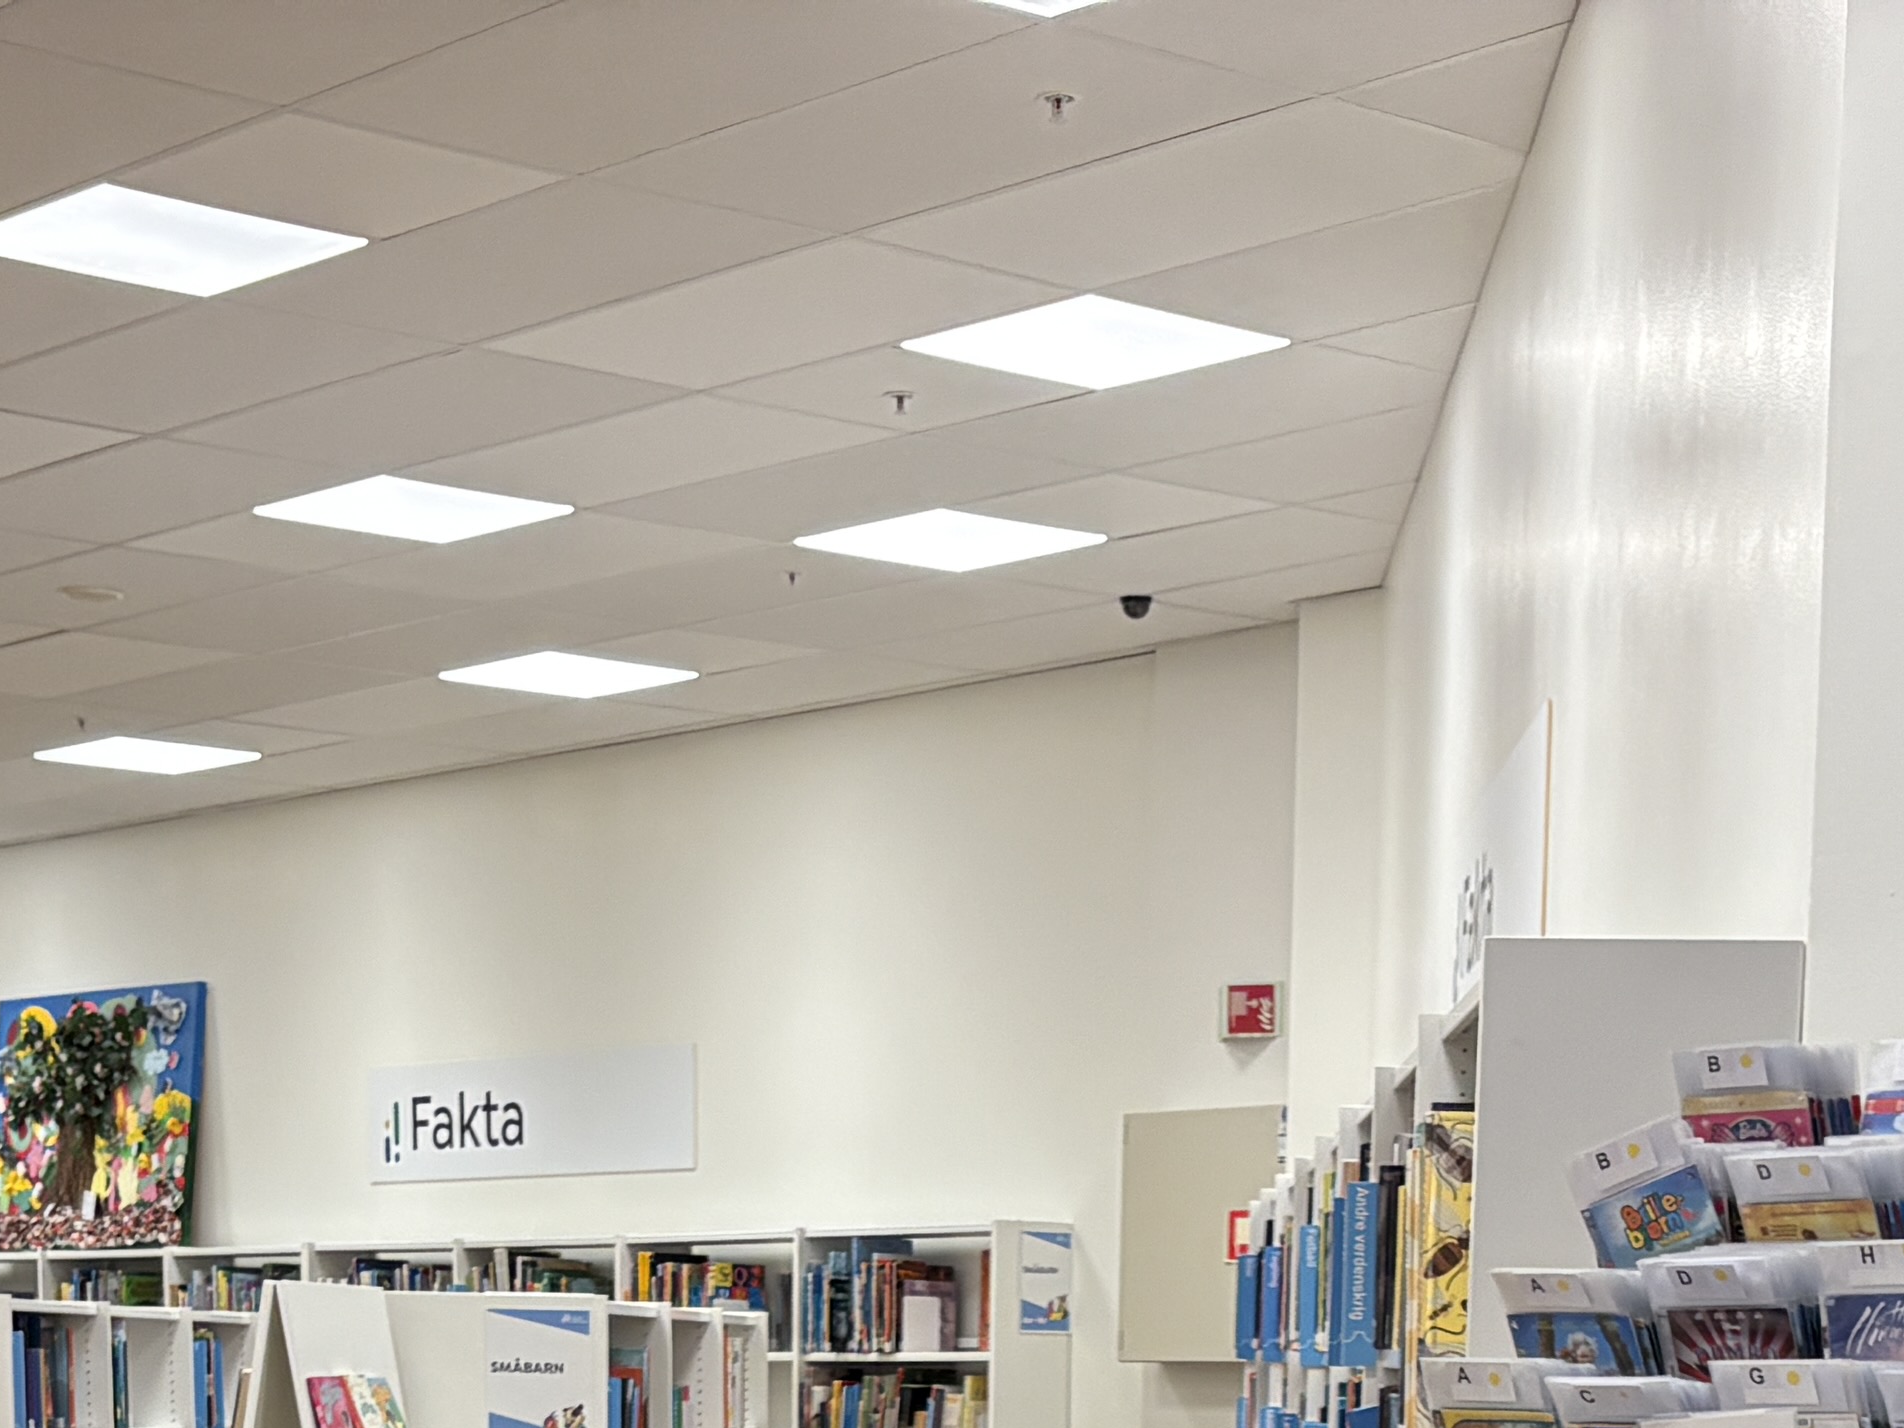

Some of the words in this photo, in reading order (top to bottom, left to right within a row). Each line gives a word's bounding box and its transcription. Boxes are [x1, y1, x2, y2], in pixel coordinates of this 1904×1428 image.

[1708, 1056, 1721, 1073] B
[412, 1091, 523, 1151] Fakta
[1597, 1152, 1611, 1170] B
[1757, 1164, 1772, 1180] D
[1355, 1187, 1370, 1231] Andre
[1861, 1246, 1876, 1264] H
[1348, 1235, 1368, 1320] verdenskrig
[1531, 1278, 1545, 1293] A
[1677, 1270, 1692, 1286] D
[490, 1357, 564, 1374] SMÅBARN
[1457, 1368, 1472, 1385] A
[1750, 1367, 1765, 1384] G
